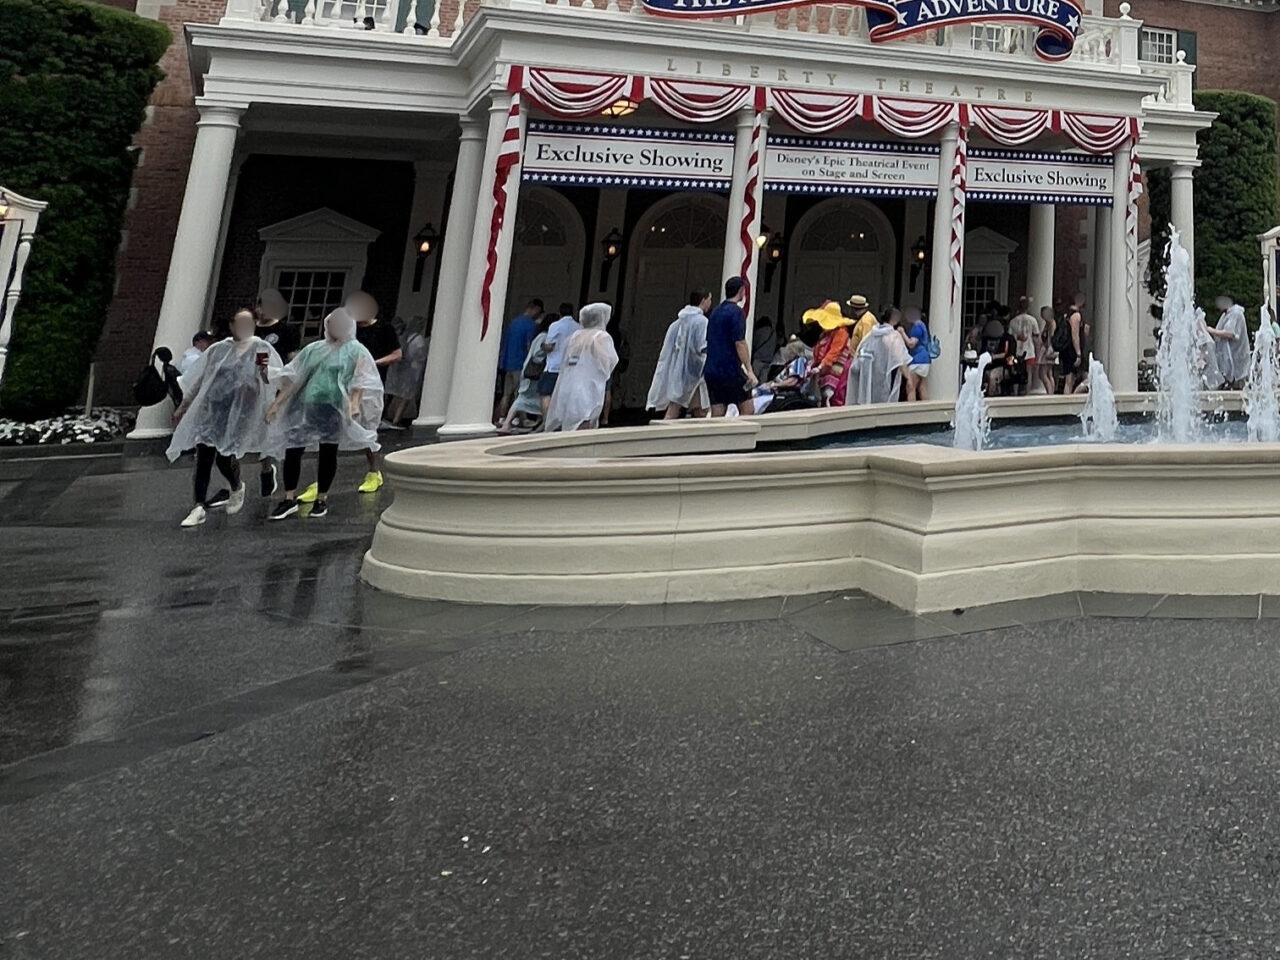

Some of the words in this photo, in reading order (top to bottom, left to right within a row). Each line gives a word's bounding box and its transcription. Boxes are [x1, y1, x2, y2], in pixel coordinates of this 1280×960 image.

[667, 58, 837, 86] LIBERTY
[876, 78, 1033, 103] THEATRE
[536, 143, 634, 165] Exclusive
[639, 148, 724, 173] Showing
[777, 153, 820, 166] Disney's
[823, 156, 846, 168] Epic
[850, 157, 899, 169] Theatrical
[902, 160, 930, 171] Event
[801, 168, 816, 177] on
[818, 167, 847, 180] Stage
[849, 170, 869, 179] and
[871, 172, 906, 181] Screen
[974, 167, 1044, 185] Exclusive
[1046, 170, 1107, 191] Showing
